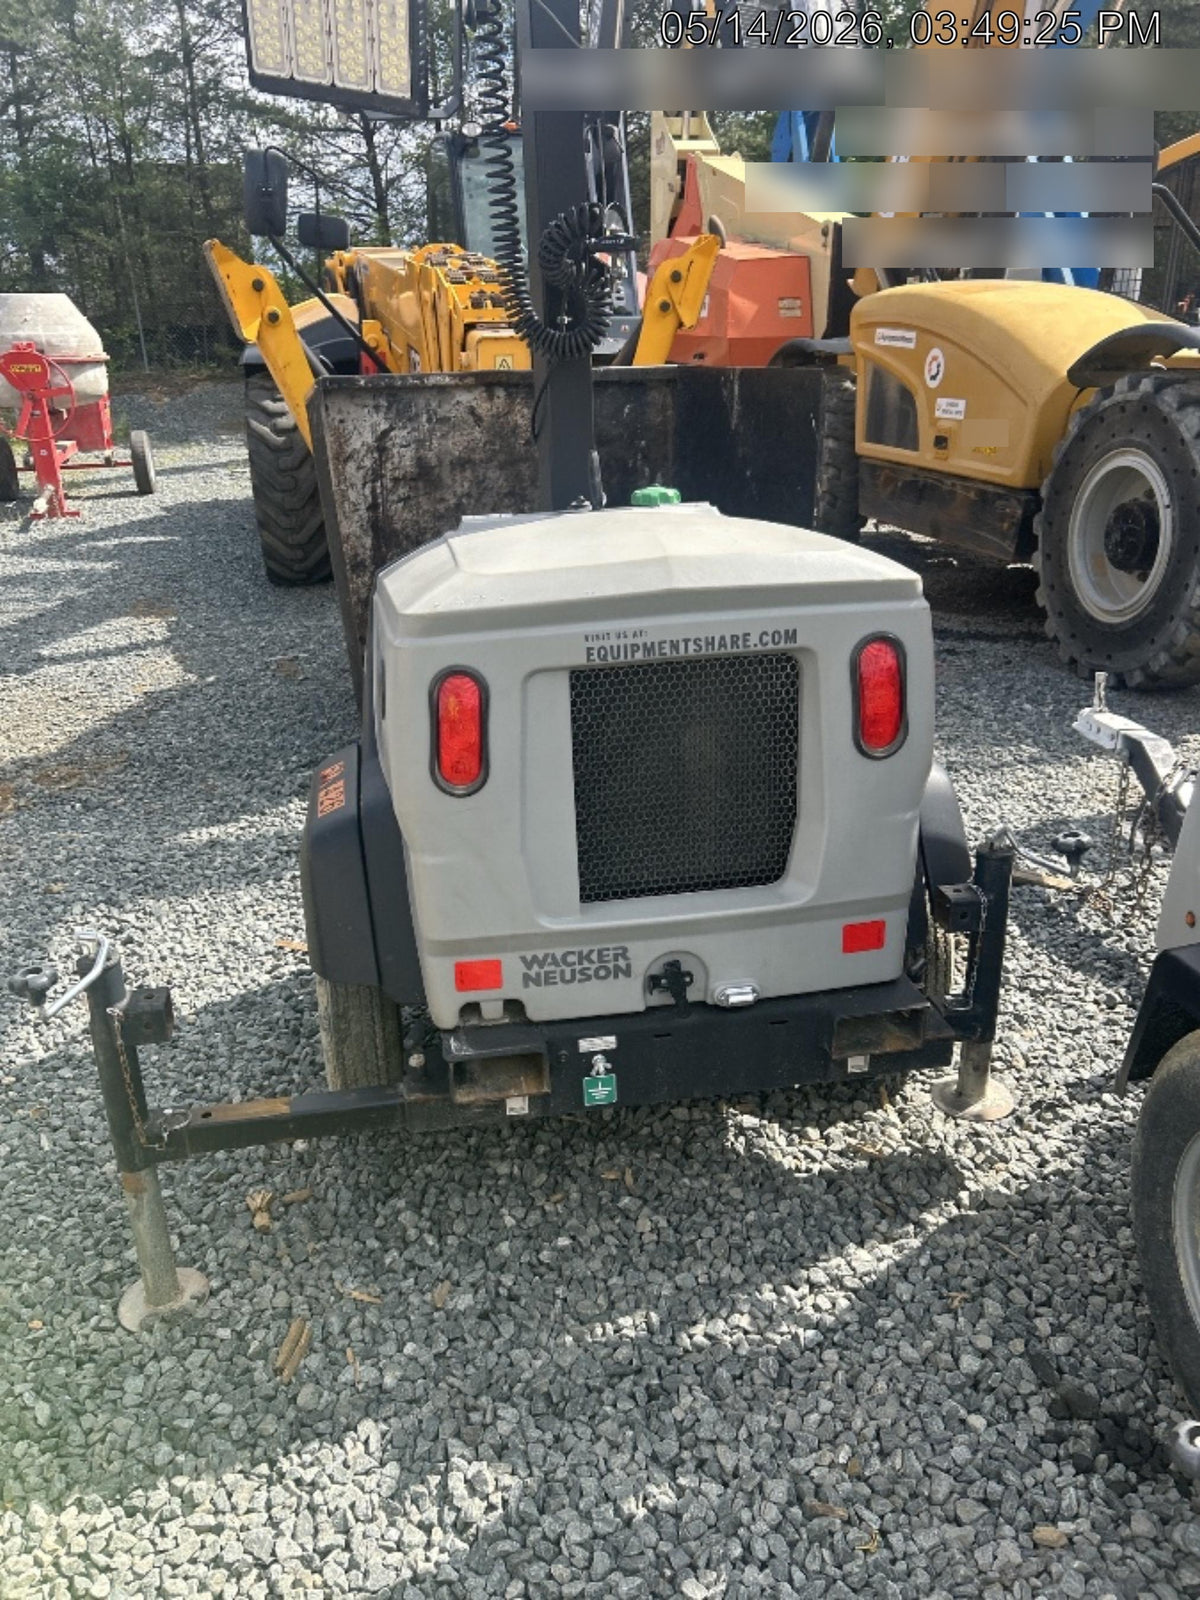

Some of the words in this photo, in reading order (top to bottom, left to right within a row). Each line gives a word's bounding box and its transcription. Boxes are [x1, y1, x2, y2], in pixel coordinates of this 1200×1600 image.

[584, 632, 611, 643] VISIT
[616, 631, 628, 640] US
[633, 629, 648, 639] AT:
[586, 628, 798, 663] EQUIPMENTSHARE.COM
[519, 945, 631, 971] WACKER
[522, 962, 632, 989] NEUSON
